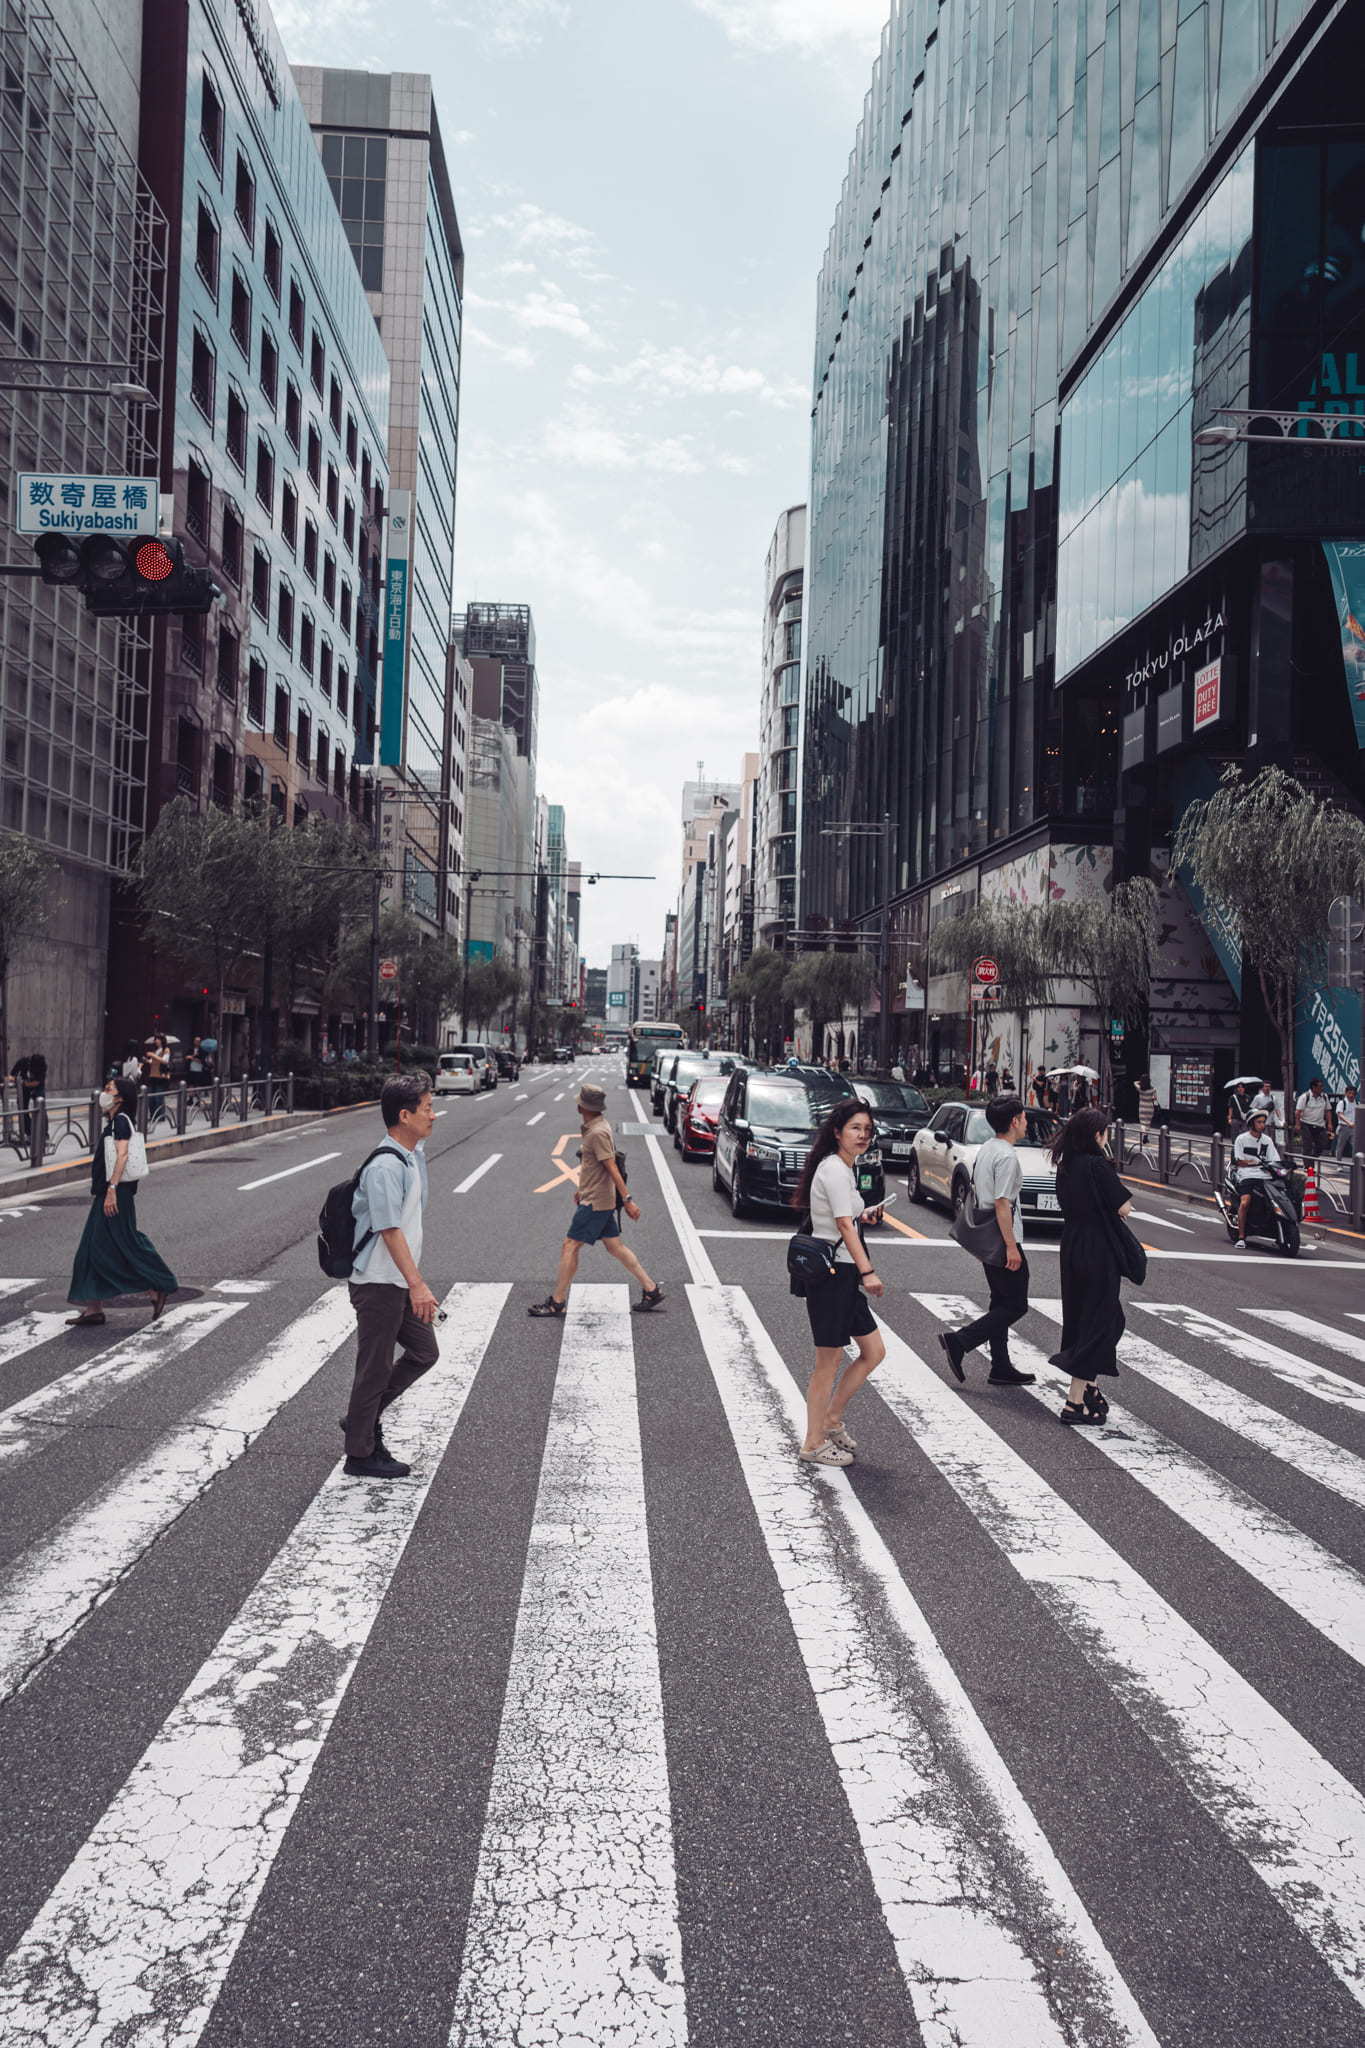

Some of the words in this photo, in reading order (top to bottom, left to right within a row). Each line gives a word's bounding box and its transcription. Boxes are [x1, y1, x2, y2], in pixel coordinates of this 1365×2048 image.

[29, 482, 148, 510] 数寄屋橋
[39, 509, 138, 531] Sukiyabashi
[388, 570, 403, 641] 東京海上日動
[1125, 651, 1169, 692] TOKYU
[1173, 612, 1224, 661] PLAZA
[1196, 665, 1219, 688] LOTTE
[1198, 684, 1216, 705] DUTY
[1197, 697, 1216, 718] FREE
